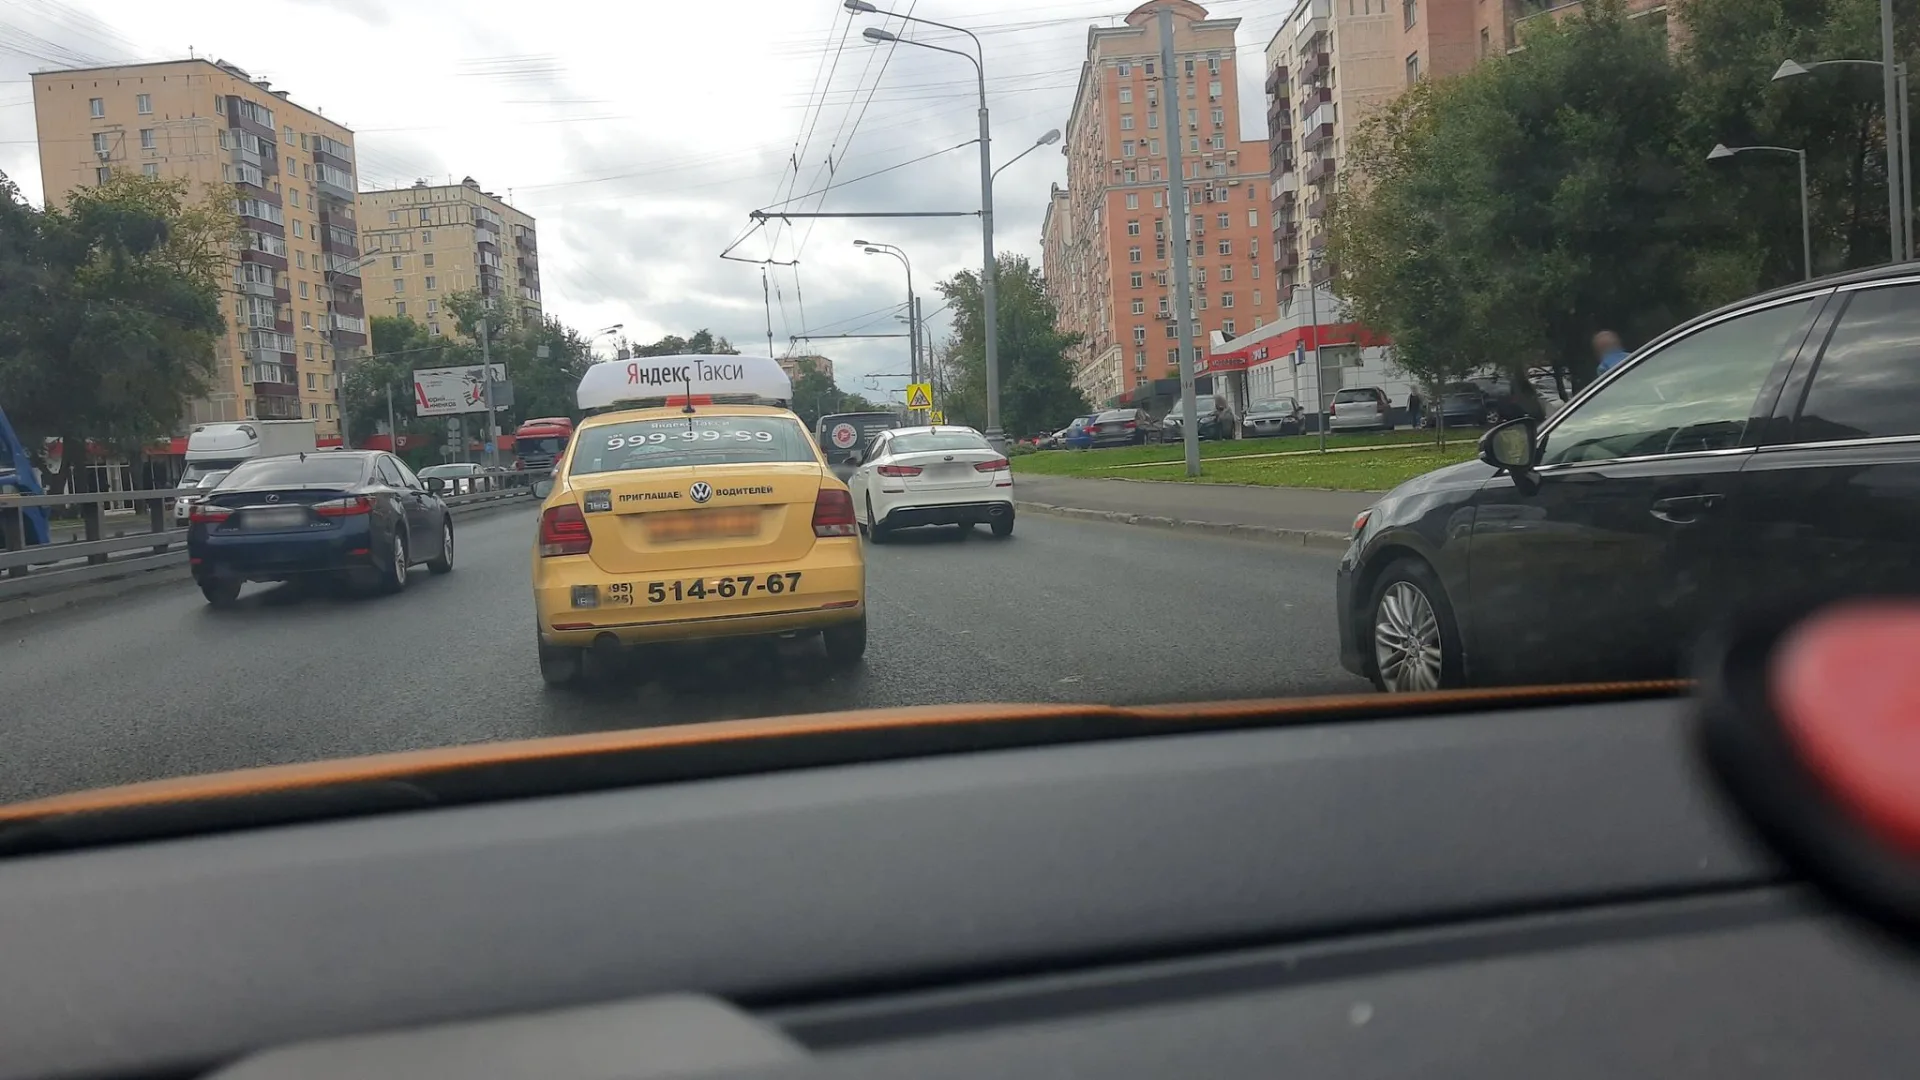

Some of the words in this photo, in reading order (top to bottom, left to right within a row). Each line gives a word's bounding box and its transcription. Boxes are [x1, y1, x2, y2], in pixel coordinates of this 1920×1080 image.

[627, 363, 690, 385] Яндекс
[694, 360, 743, 381] Такси
[618, 491, 683, 502] ПРИГЛАШАЕ
[716, 485, 773, 497] ВОДИТЕЛЕЙ
[648, 571, 802, 603] 514-67-67
